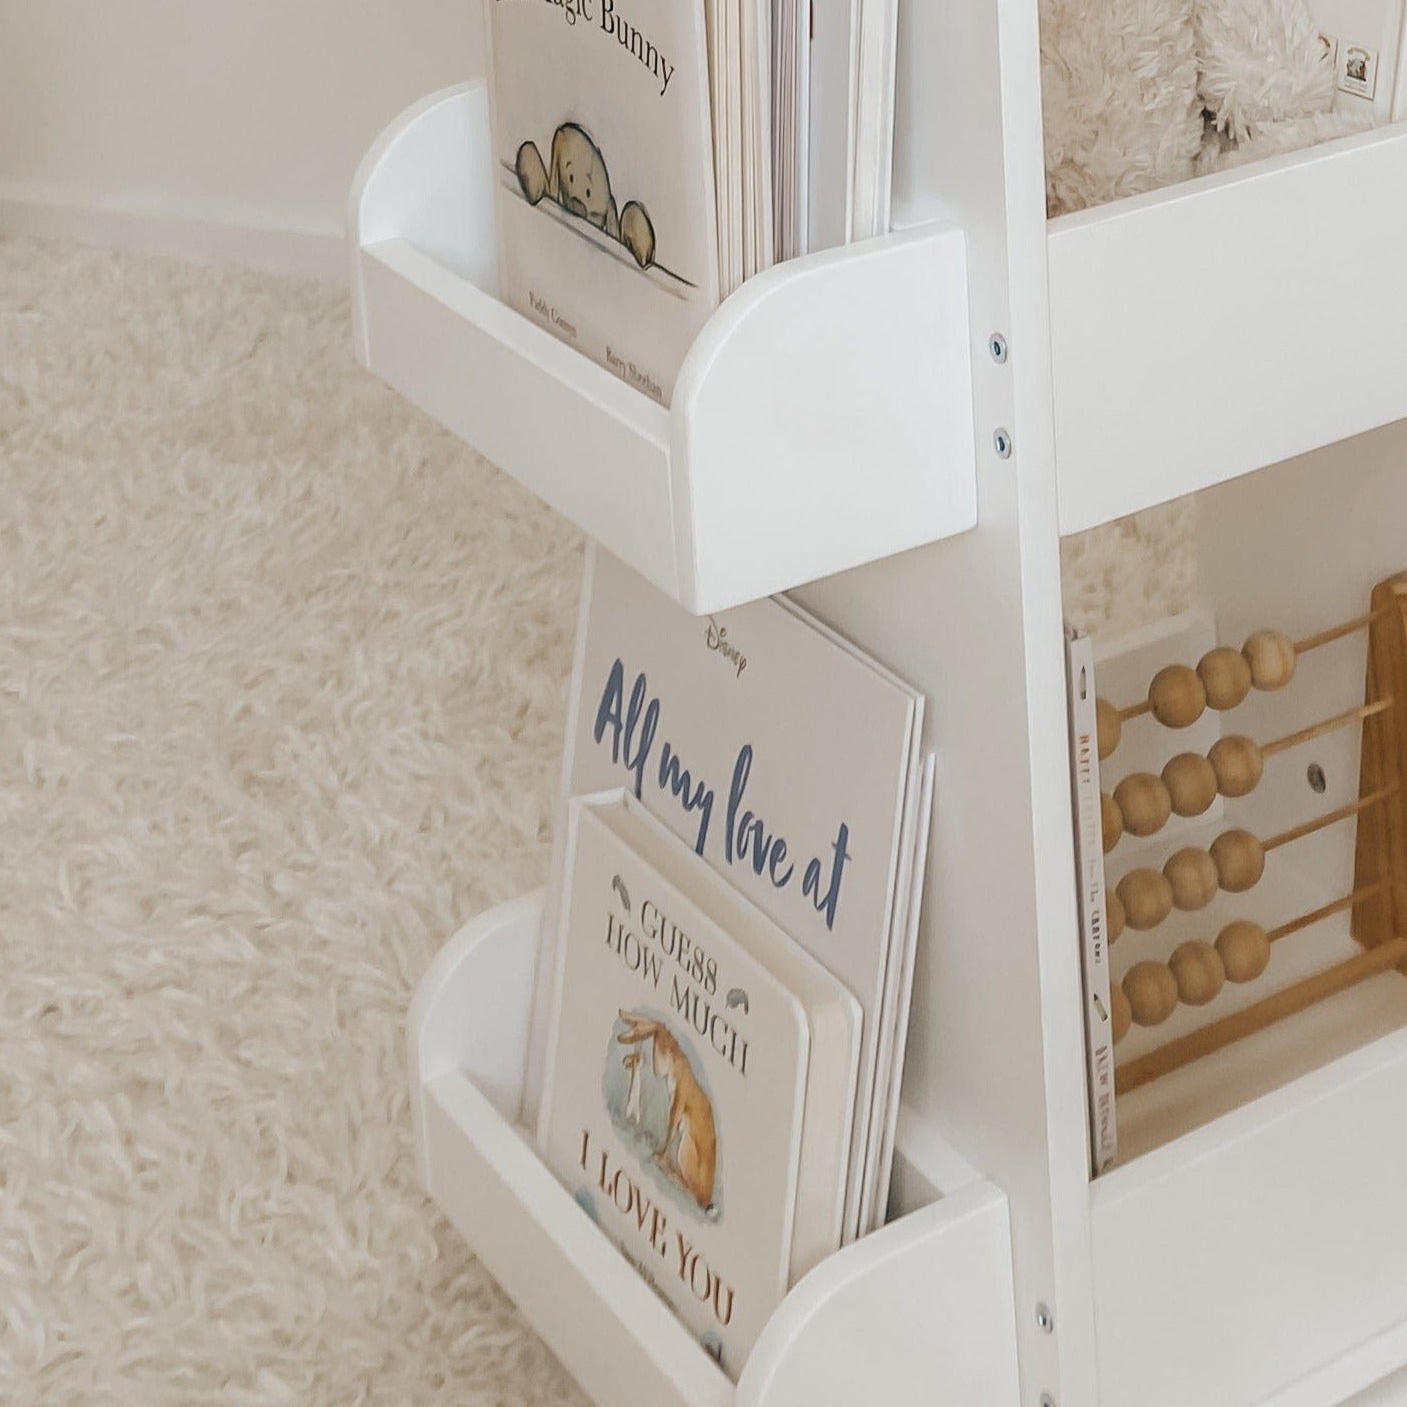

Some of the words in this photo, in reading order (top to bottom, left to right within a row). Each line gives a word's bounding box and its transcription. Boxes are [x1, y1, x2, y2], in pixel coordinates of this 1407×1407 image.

[594, 657, 660, 801] All
[658, 742, 714, 857] my
[725, 744, 794, 888] love
[803, 822, 852, 931] at
[605, 913, 664, 989] HOW
[670, 974, 748, 1078] MUCH
[641, 900, 718, 996] GUESS
[581, 1128, 589, 1171] I
[599, 1151, 667, 1259] LOVE
[676, 1228, 735, 1326] YOU
